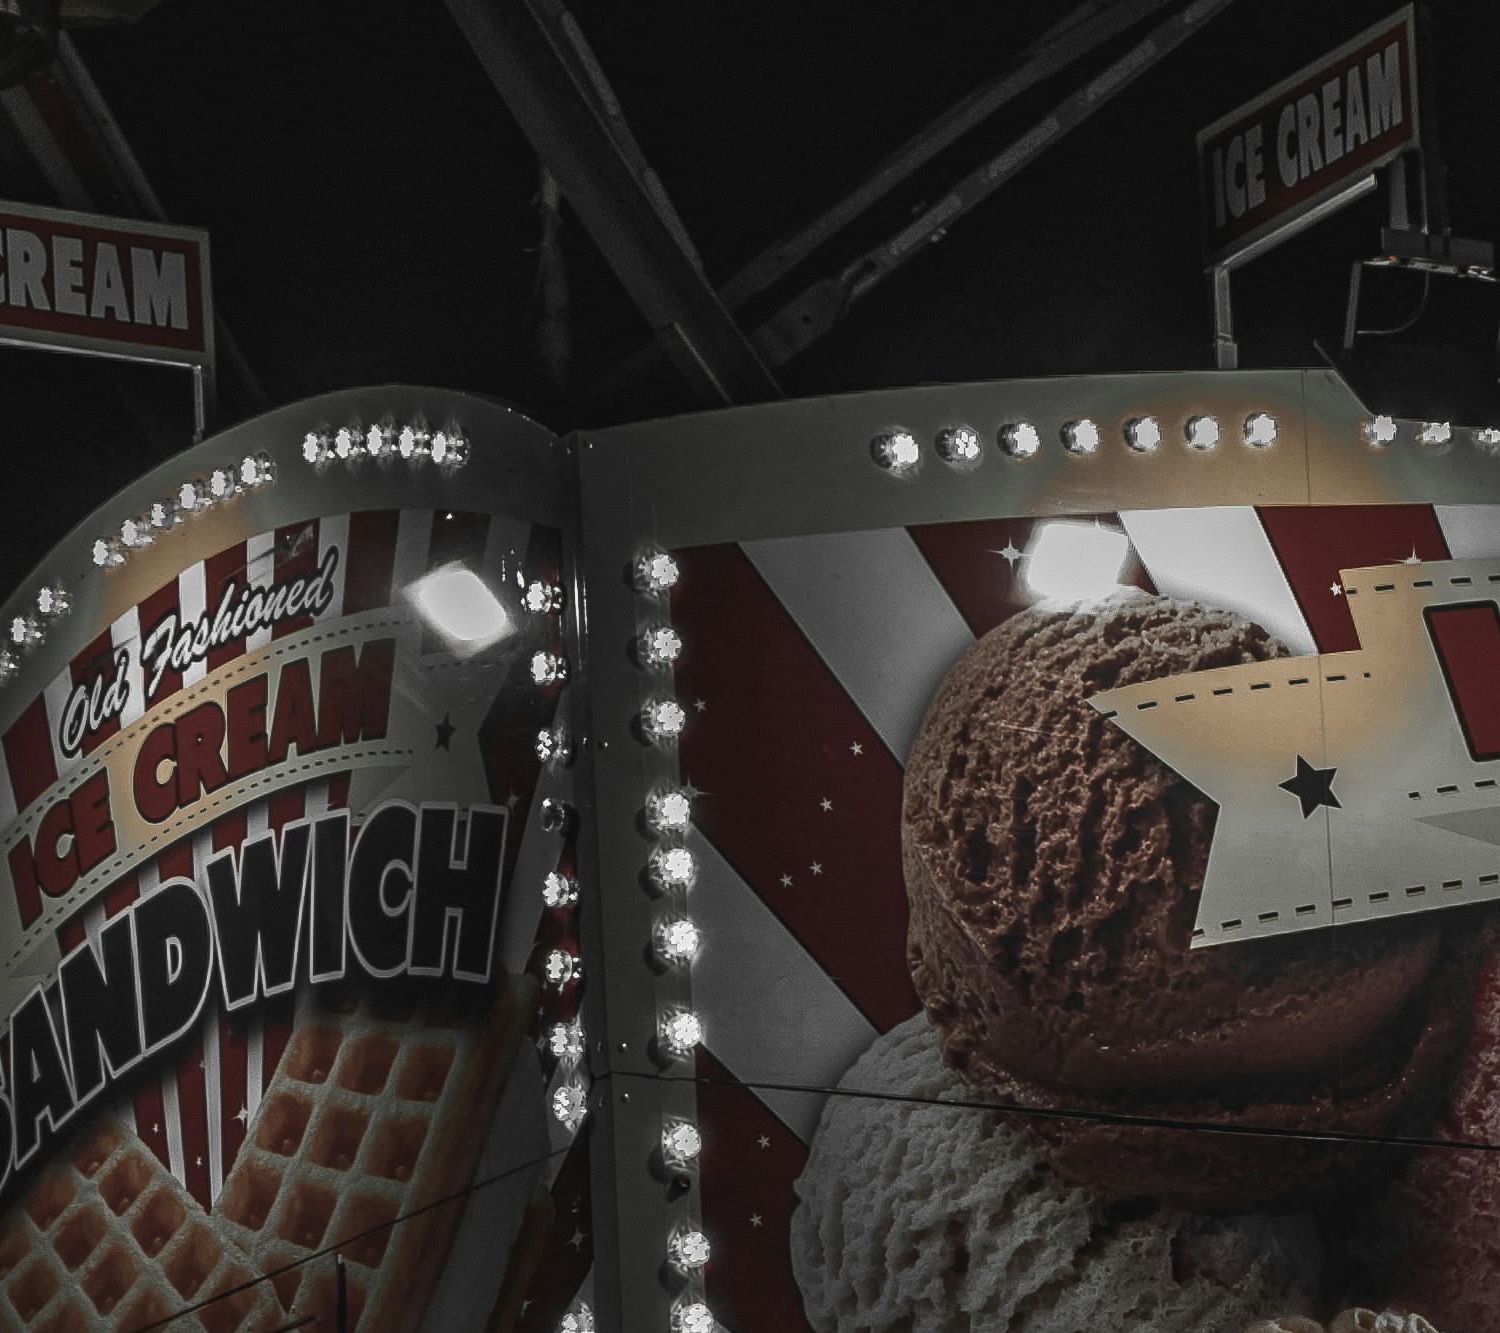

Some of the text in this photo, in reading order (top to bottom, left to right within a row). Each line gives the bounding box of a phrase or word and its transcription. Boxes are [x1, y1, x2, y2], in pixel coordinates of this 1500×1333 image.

[1212, 41, 1403, 229] ICE CREAM
[59, 547, 340, 758] Old Fashioned
[7, 636, 394, 930] ICE CREAM
